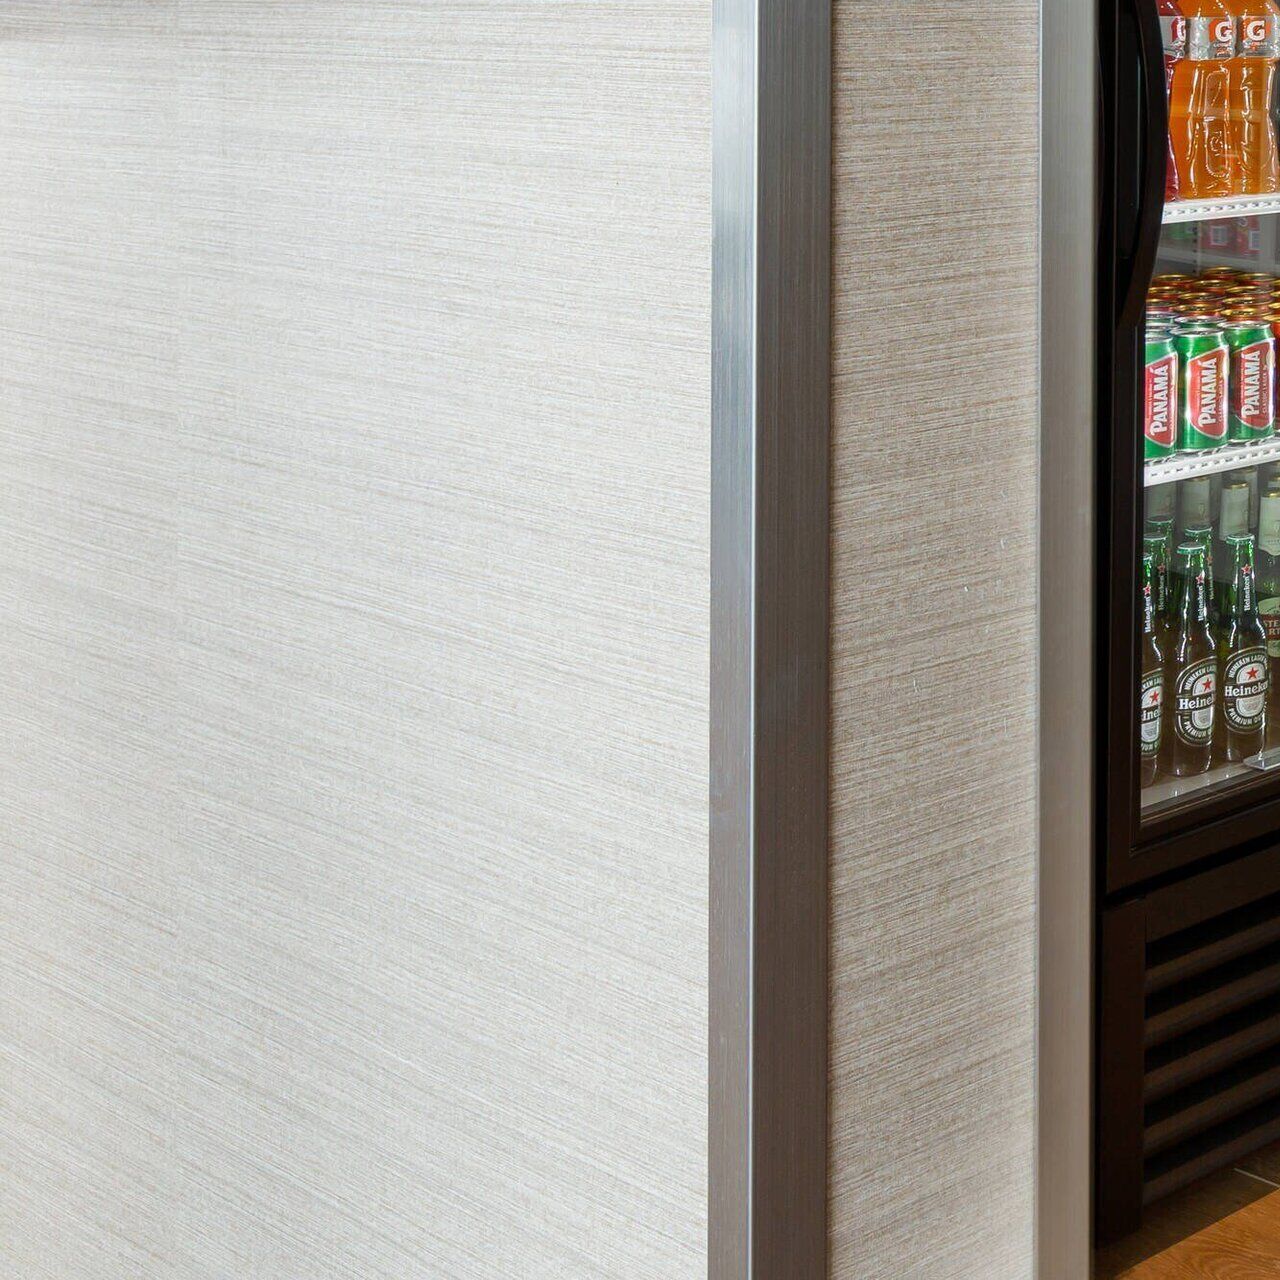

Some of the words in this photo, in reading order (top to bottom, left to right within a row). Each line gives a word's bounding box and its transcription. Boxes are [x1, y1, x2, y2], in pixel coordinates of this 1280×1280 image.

[1215, 21, 1232, 43] G
[1246, 20, 1265, 42] G
[1178, 694, 1215, 711] Heine
